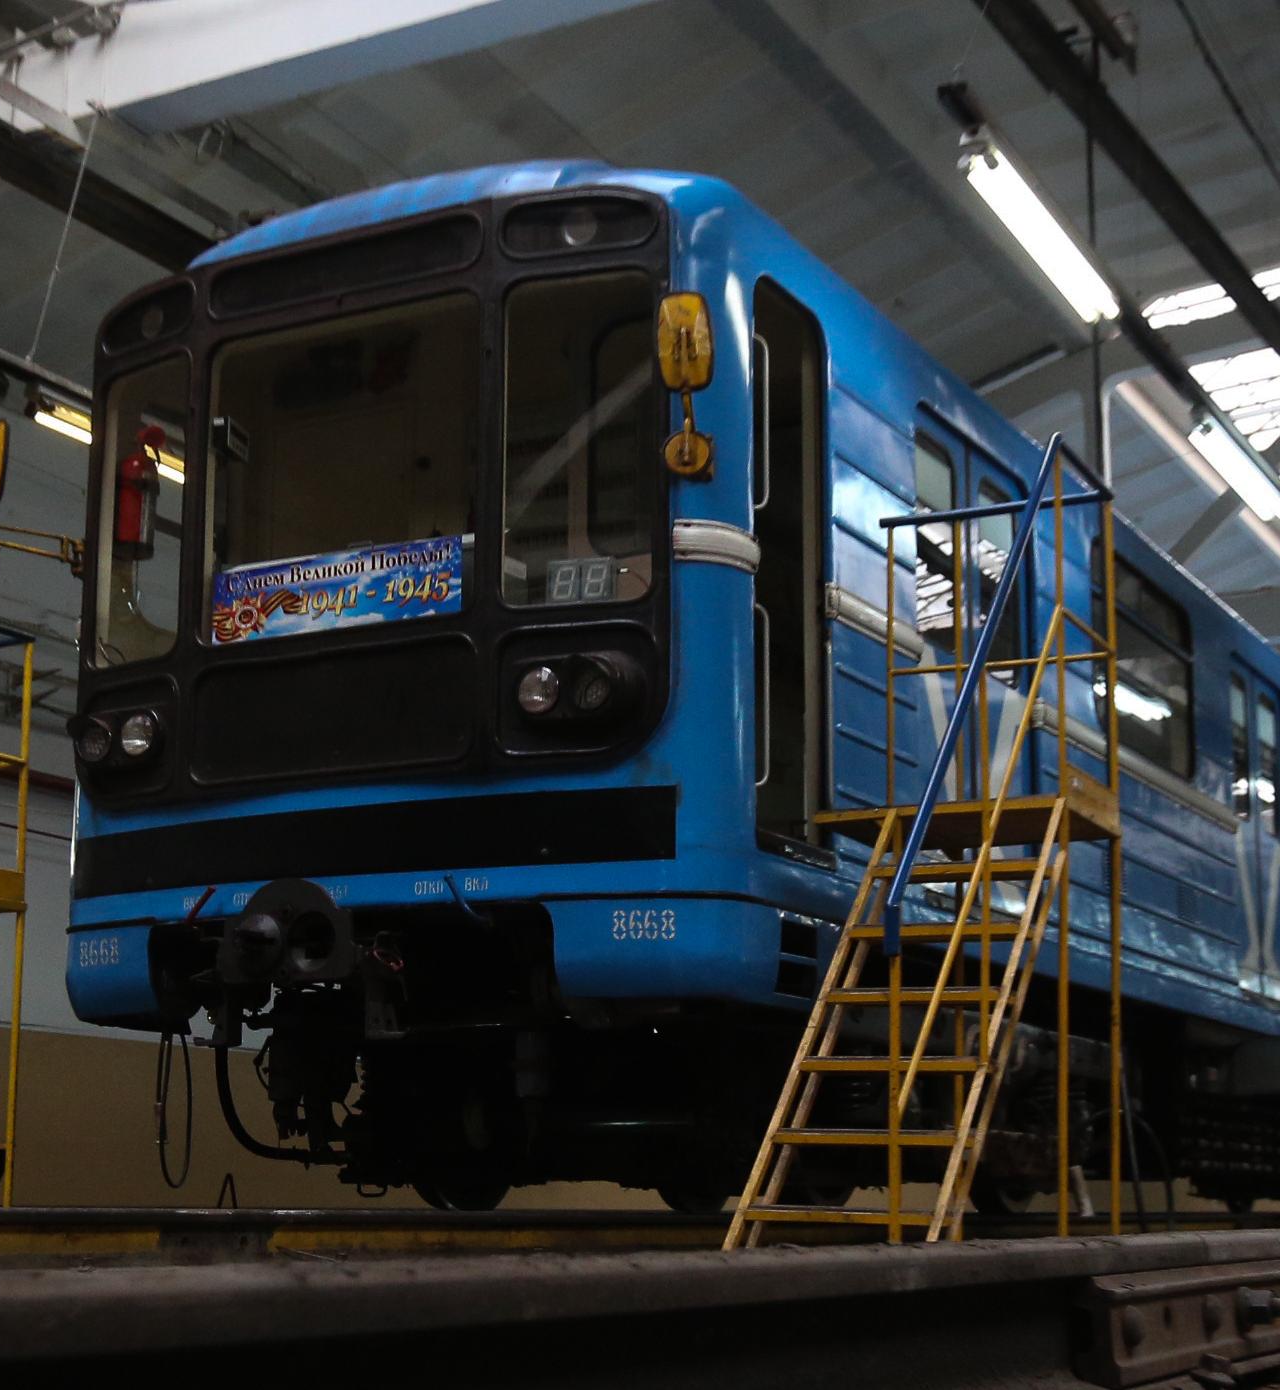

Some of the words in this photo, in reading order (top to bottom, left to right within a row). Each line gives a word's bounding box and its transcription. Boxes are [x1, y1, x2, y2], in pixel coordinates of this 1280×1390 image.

[290, 556, 365, 583] Великой
[371, 541, 453, 571] Победы!
[300, 584, 359, 620] 1941
[382, 571, 453, 607] 1945
[613, 909, 676, 940] 8668
[80, 937, 119, 967] 8668
